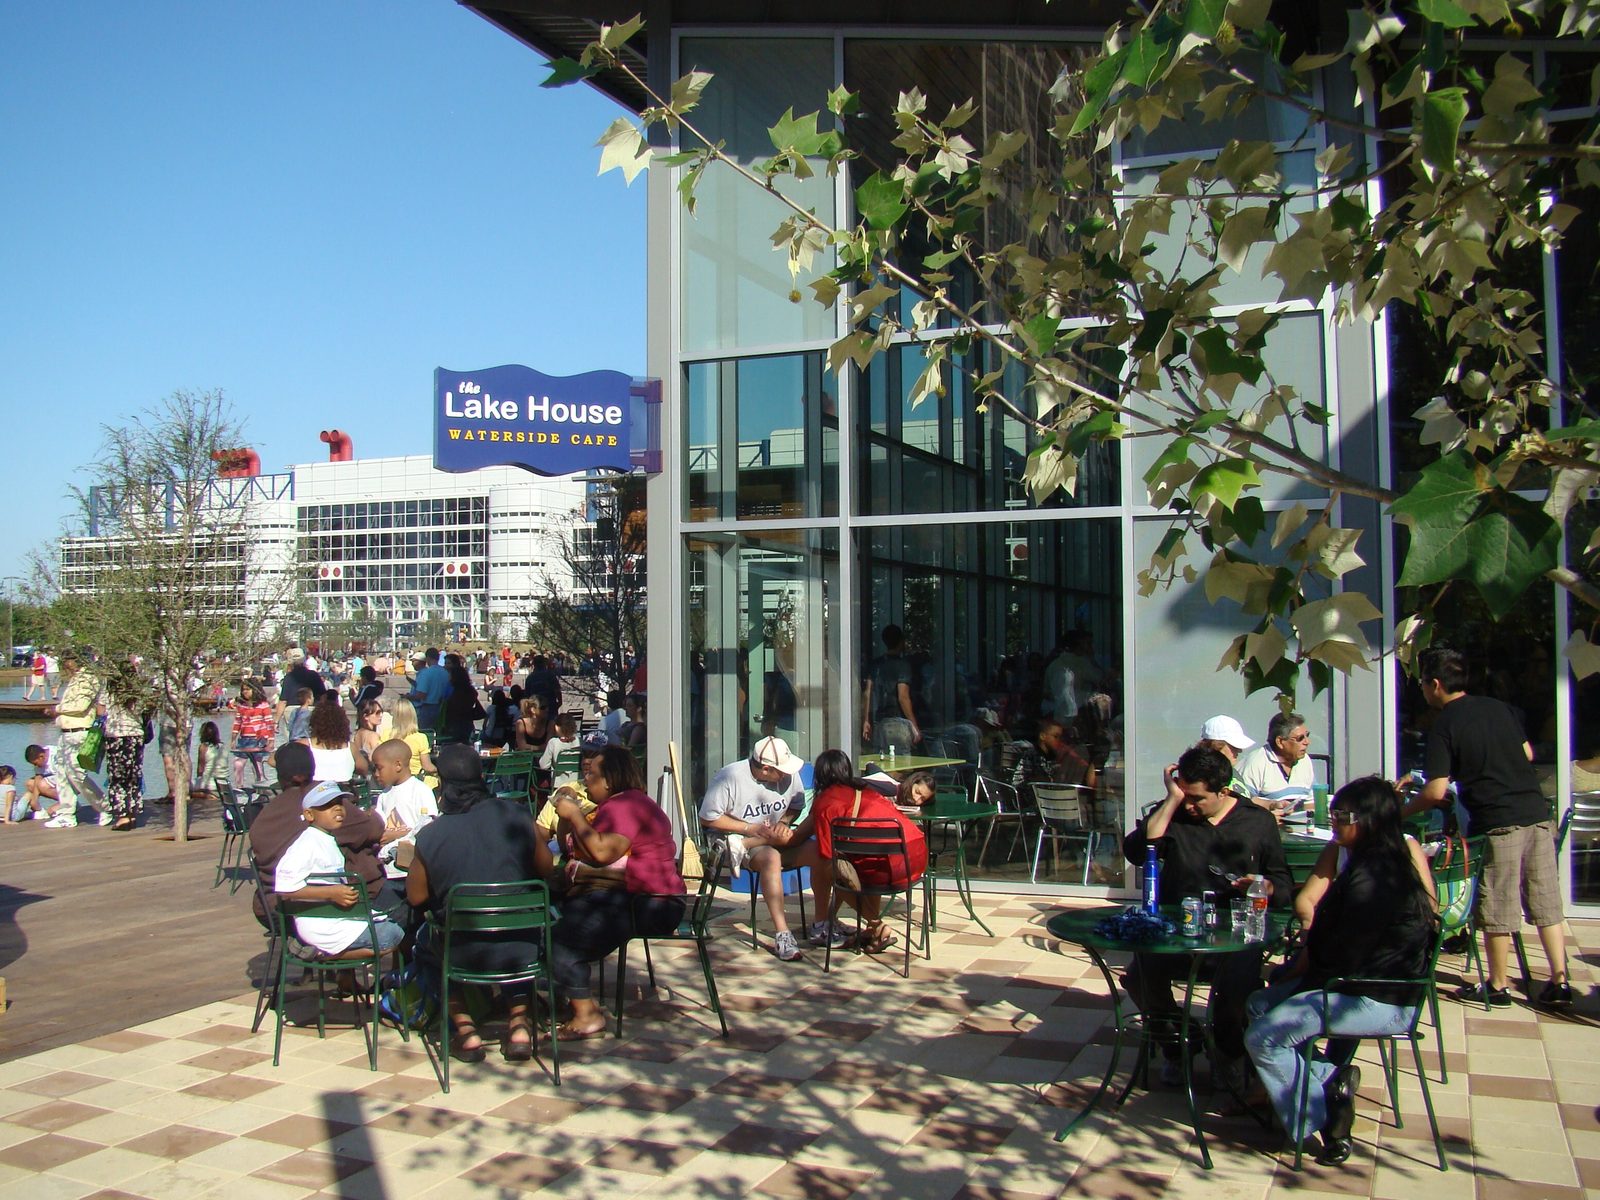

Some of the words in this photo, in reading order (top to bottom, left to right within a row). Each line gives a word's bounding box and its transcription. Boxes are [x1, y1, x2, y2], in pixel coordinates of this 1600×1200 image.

[458, 381, 480, 394] the
[445, 391, 519, 420] Lake
[528, 395, 622, 425] House
[449, 429, 561, 444] WATERSIDE
[571, 434, 618, 446] CAFE
[742, 798, 787, 819] Astros
